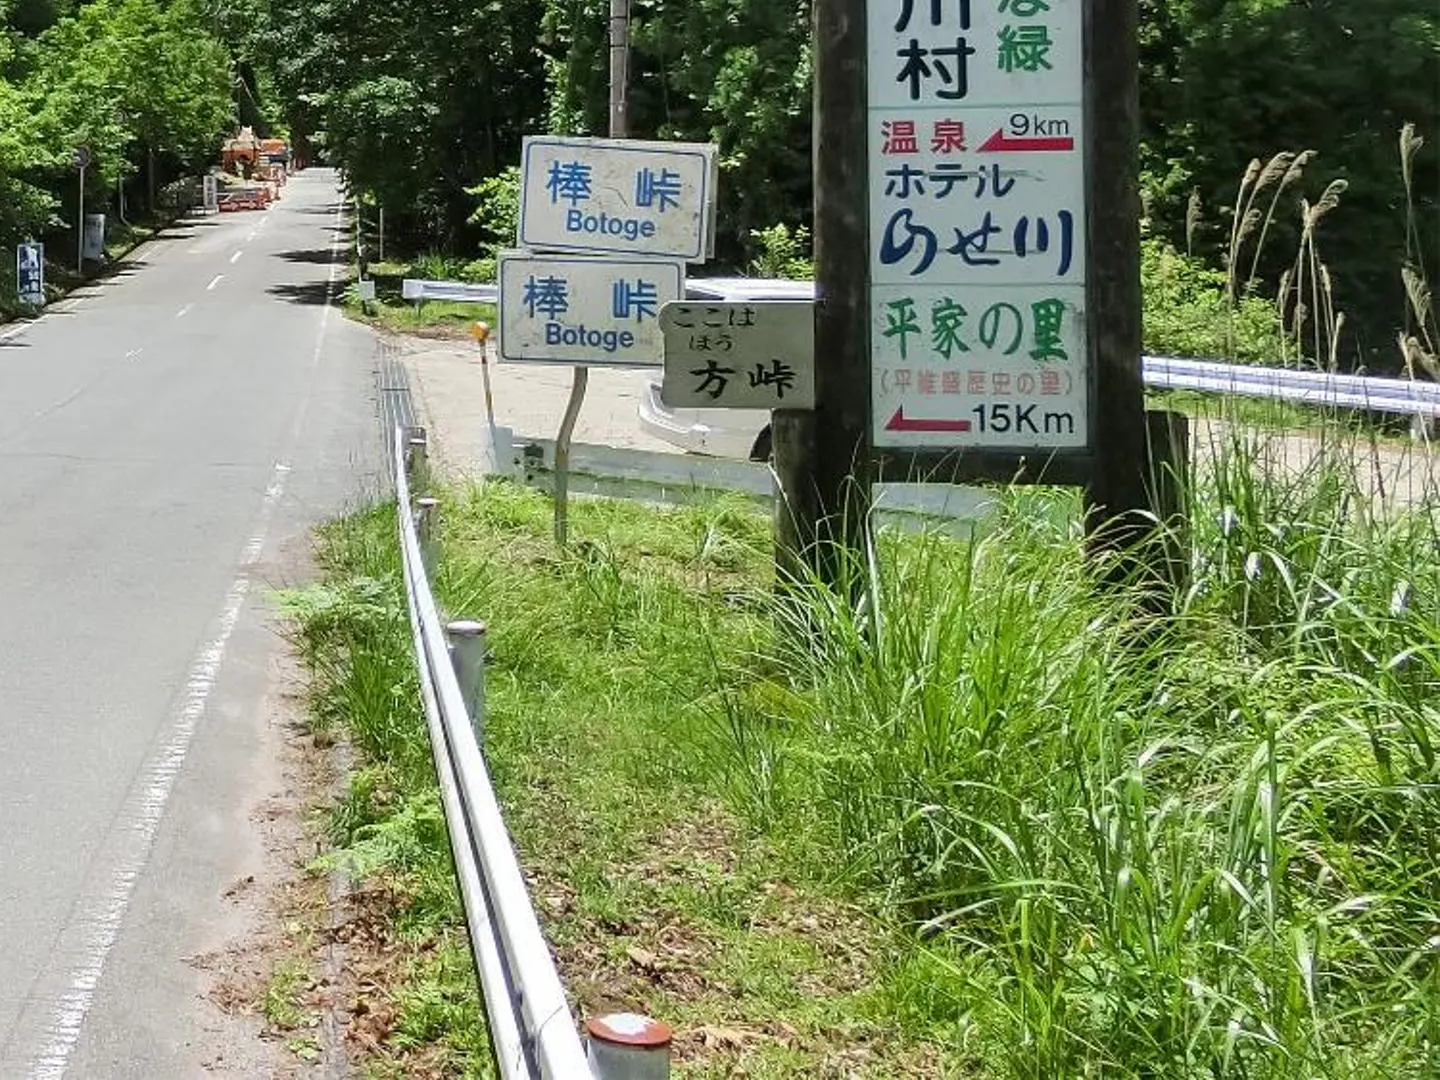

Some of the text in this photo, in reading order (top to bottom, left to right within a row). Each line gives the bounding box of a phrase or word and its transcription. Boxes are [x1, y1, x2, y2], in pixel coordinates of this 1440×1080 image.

[880, 118, 967, 154] 温泉
[1010, 113, 1069, 136] 9km
[546, 160, 682, 212] 棒峠
[885, 163, 1015, 199] ホテル
[566, 209, 656, 240] Botoge
[879, 207, 1073, 276] のせ川
[523, 274, 658, 323] 棒峠
[673, 307, 755, 328] ここは
[882, 297, 1070, 361] 平家の里
[545, 323, 634, 352] Botoge
[689, 359, 796, 399] 方峠
[972, 404, 1074, 434] 15Km
